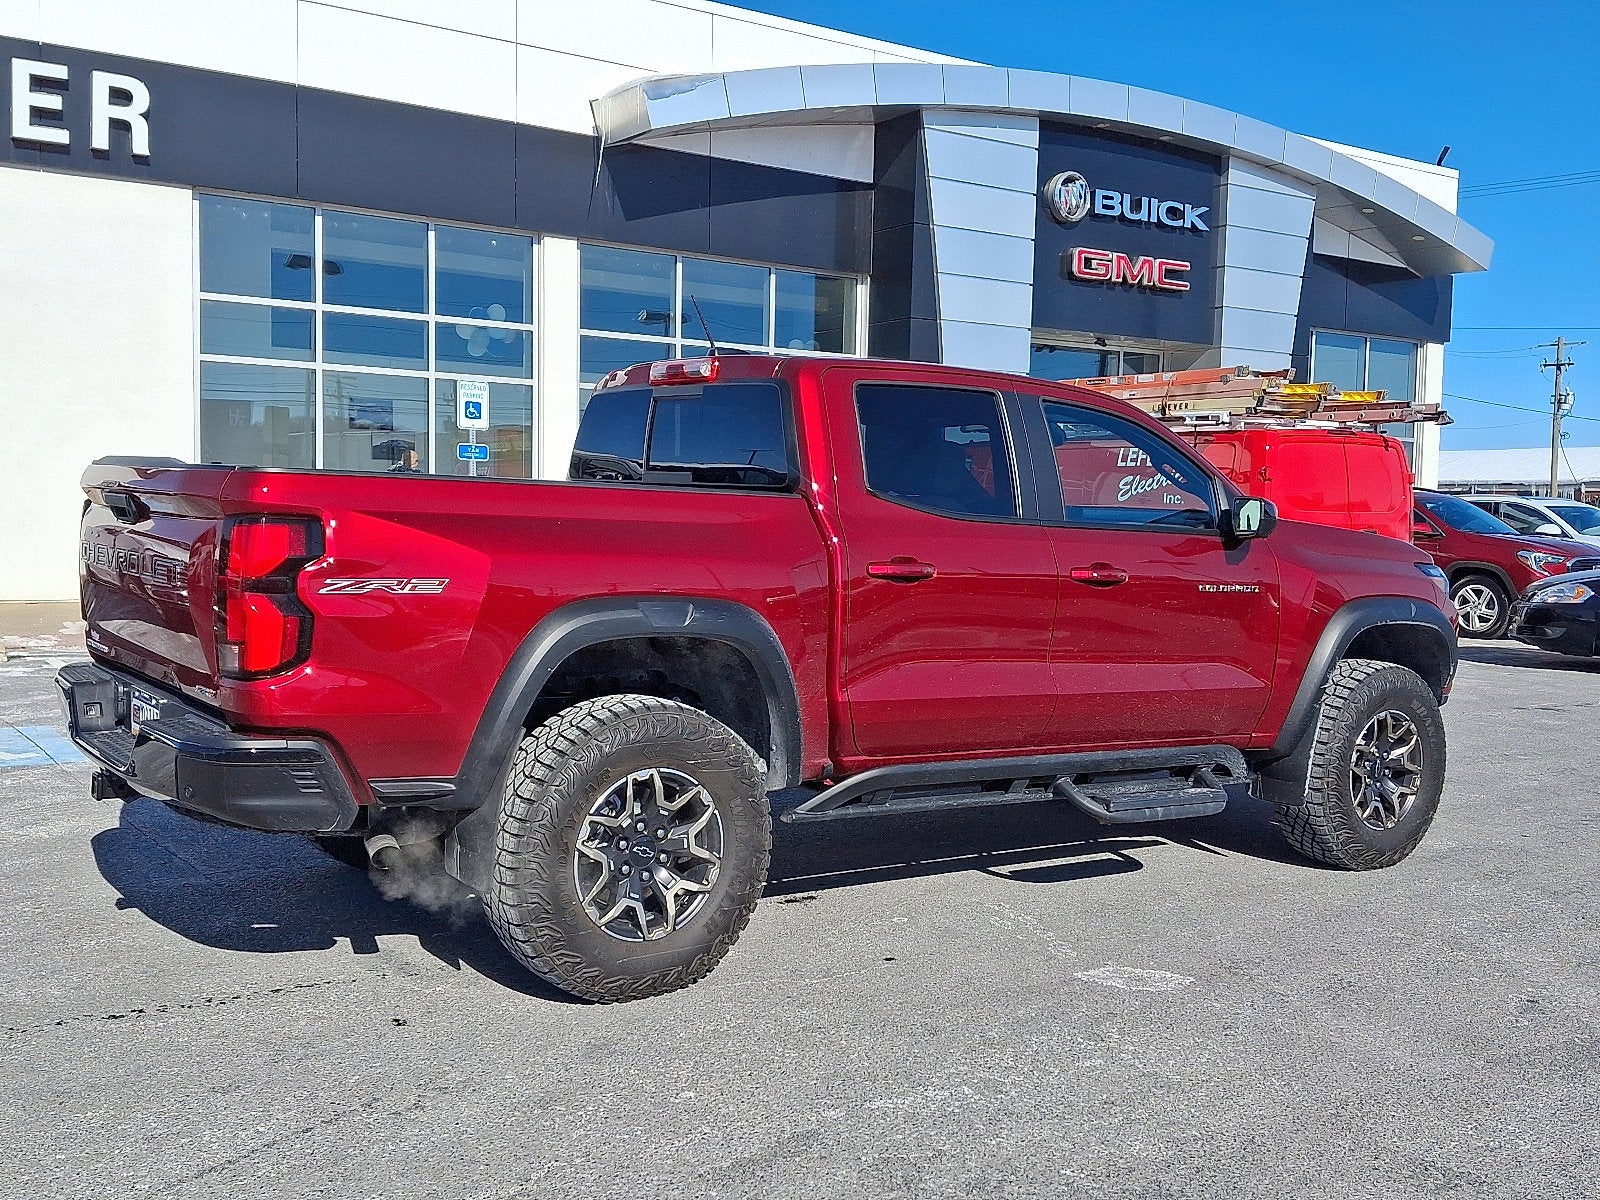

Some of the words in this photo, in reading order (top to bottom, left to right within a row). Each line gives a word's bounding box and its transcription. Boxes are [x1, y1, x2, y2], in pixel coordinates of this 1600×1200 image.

[10, 57, 151, 156] ER
[1094, 188, 1211, 232] BUICK
[1070, 246, 1192, 292] GMC
[461, 384, 487, 392] RESERVED
[1163, 492, 1185, 504] Inc.
[81, 541, 184, 588] CHEVROLET
[317, 578, 450, 594] ZR2
